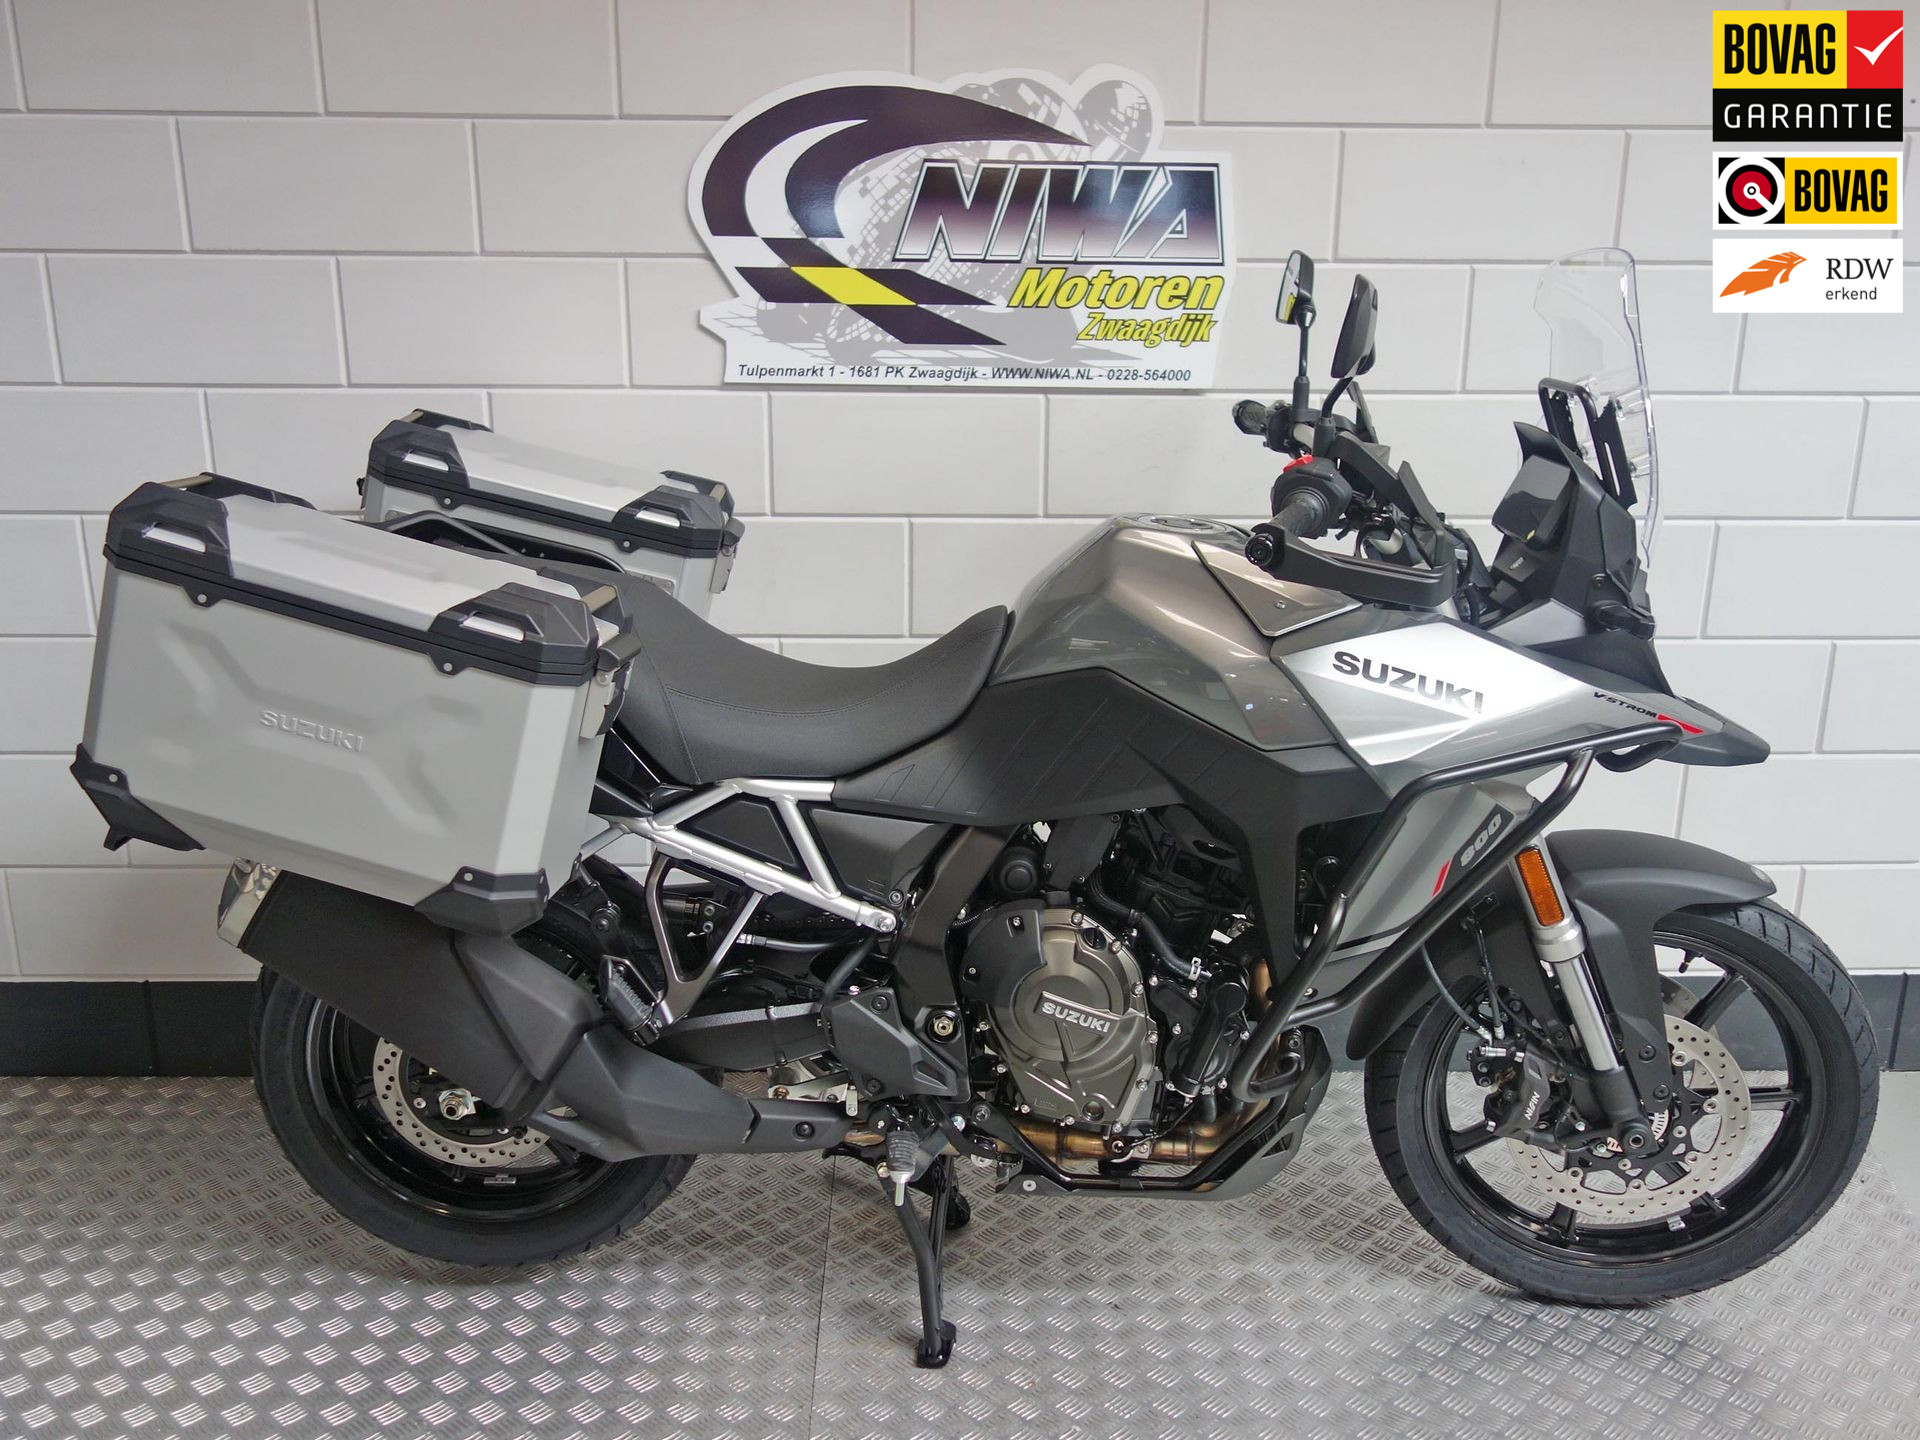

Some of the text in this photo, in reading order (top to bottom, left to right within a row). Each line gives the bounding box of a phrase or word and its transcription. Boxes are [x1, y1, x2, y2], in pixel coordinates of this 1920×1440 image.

[892, 158, 1224, 266] NIWA
[1006, 267, 1225, 311] Motoren
[1076, 312, 1218, 348] Zwaagdijk
[738, 364, 825, 379] Tulpenmarkt
[828, 365, 835, 377] 1
[850, 366, 880, 378] 1681
[884, 366, 905, 378] PK
[909, 366, 978, 381] Zwaagdijk
[991, 367, 1094, 380] WWW.NIWA.NL
[1107, 369, 1192, 381] 0228-564000
[1332, 651, 1484, 714] SUZUKI
[1593, 691, 1658, 718] V-STROM
[260, 710, 364, 751] SUZUKI
[1460, 813, 1502, 867] 800
[1041, 1001, 1111, 1033] SUZUKI
